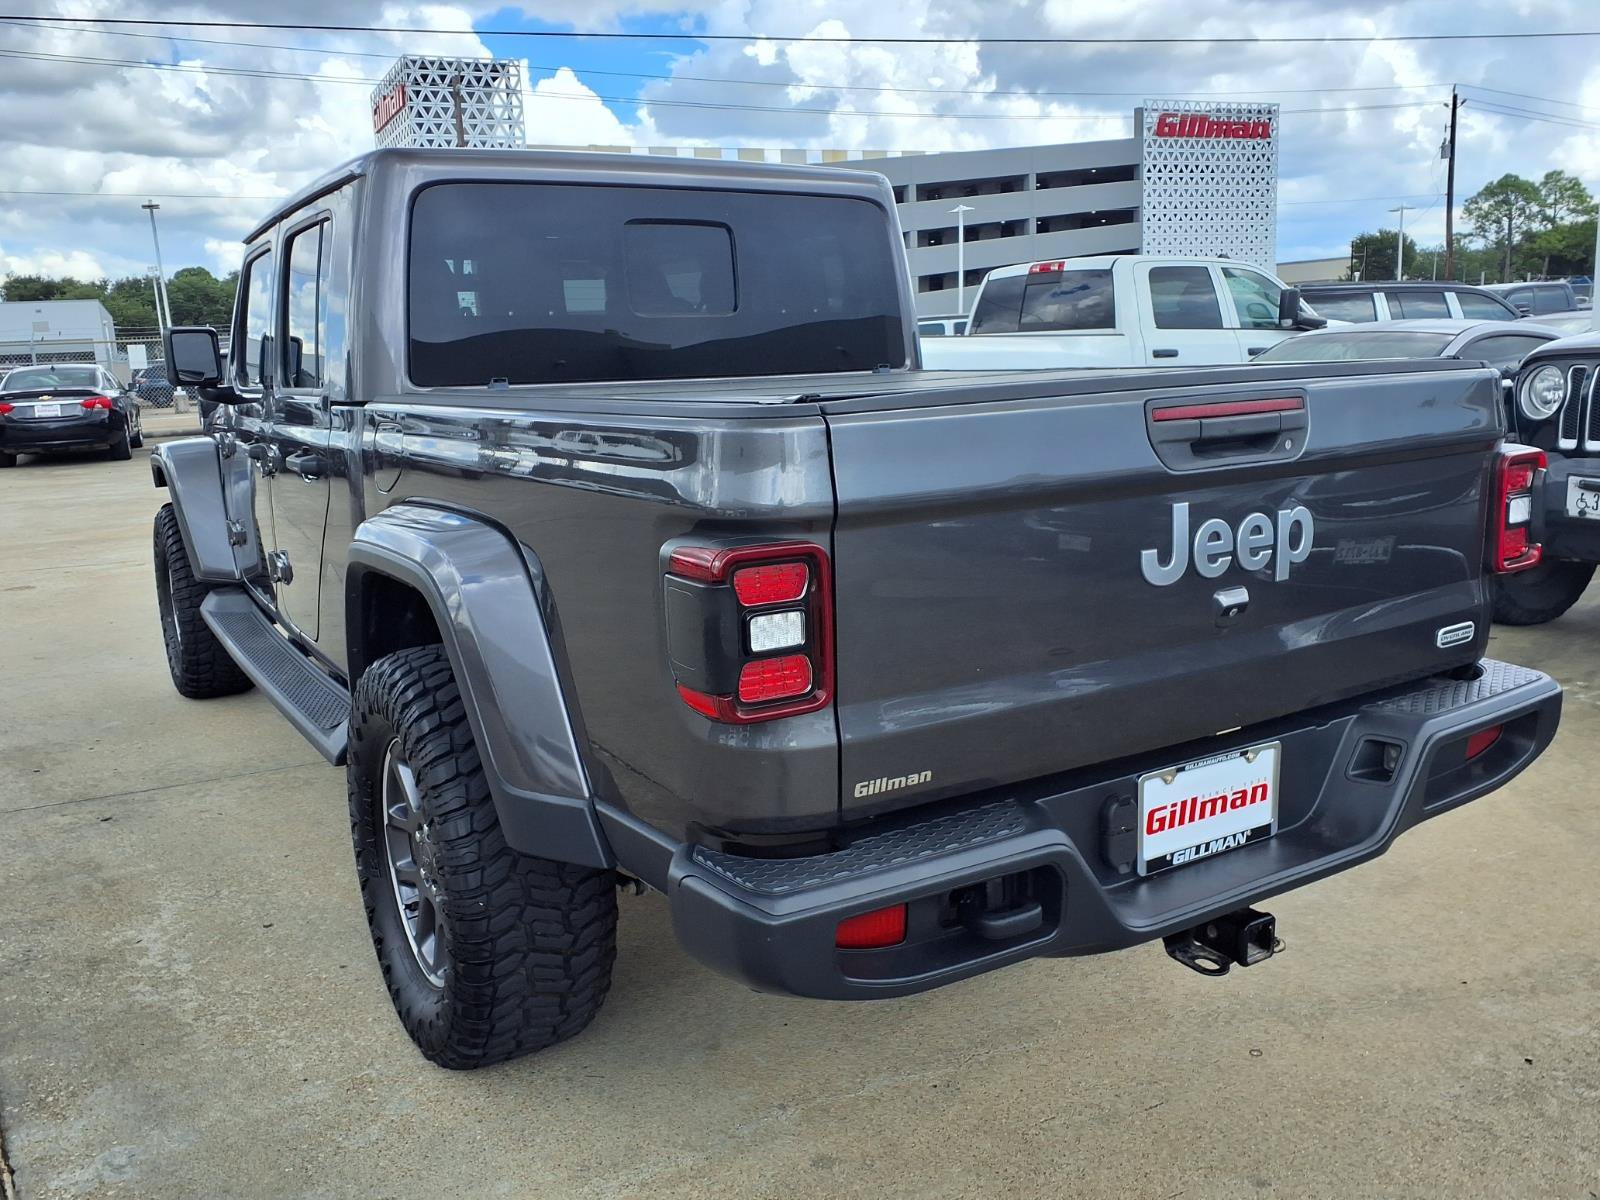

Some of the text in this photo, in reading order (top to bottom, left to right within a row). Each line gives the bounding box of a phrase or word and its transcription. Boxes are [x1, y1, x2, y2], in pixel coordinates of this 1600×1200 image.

[1155, 113, 1271, 139] Gillman
[1140, 502, 1314, 587] Jeep
[854, 770, 932, 798] Gillman
[1146, 782, 1269, 836] Gillman
[1172, 831, 1247, 865] GILLMAN
